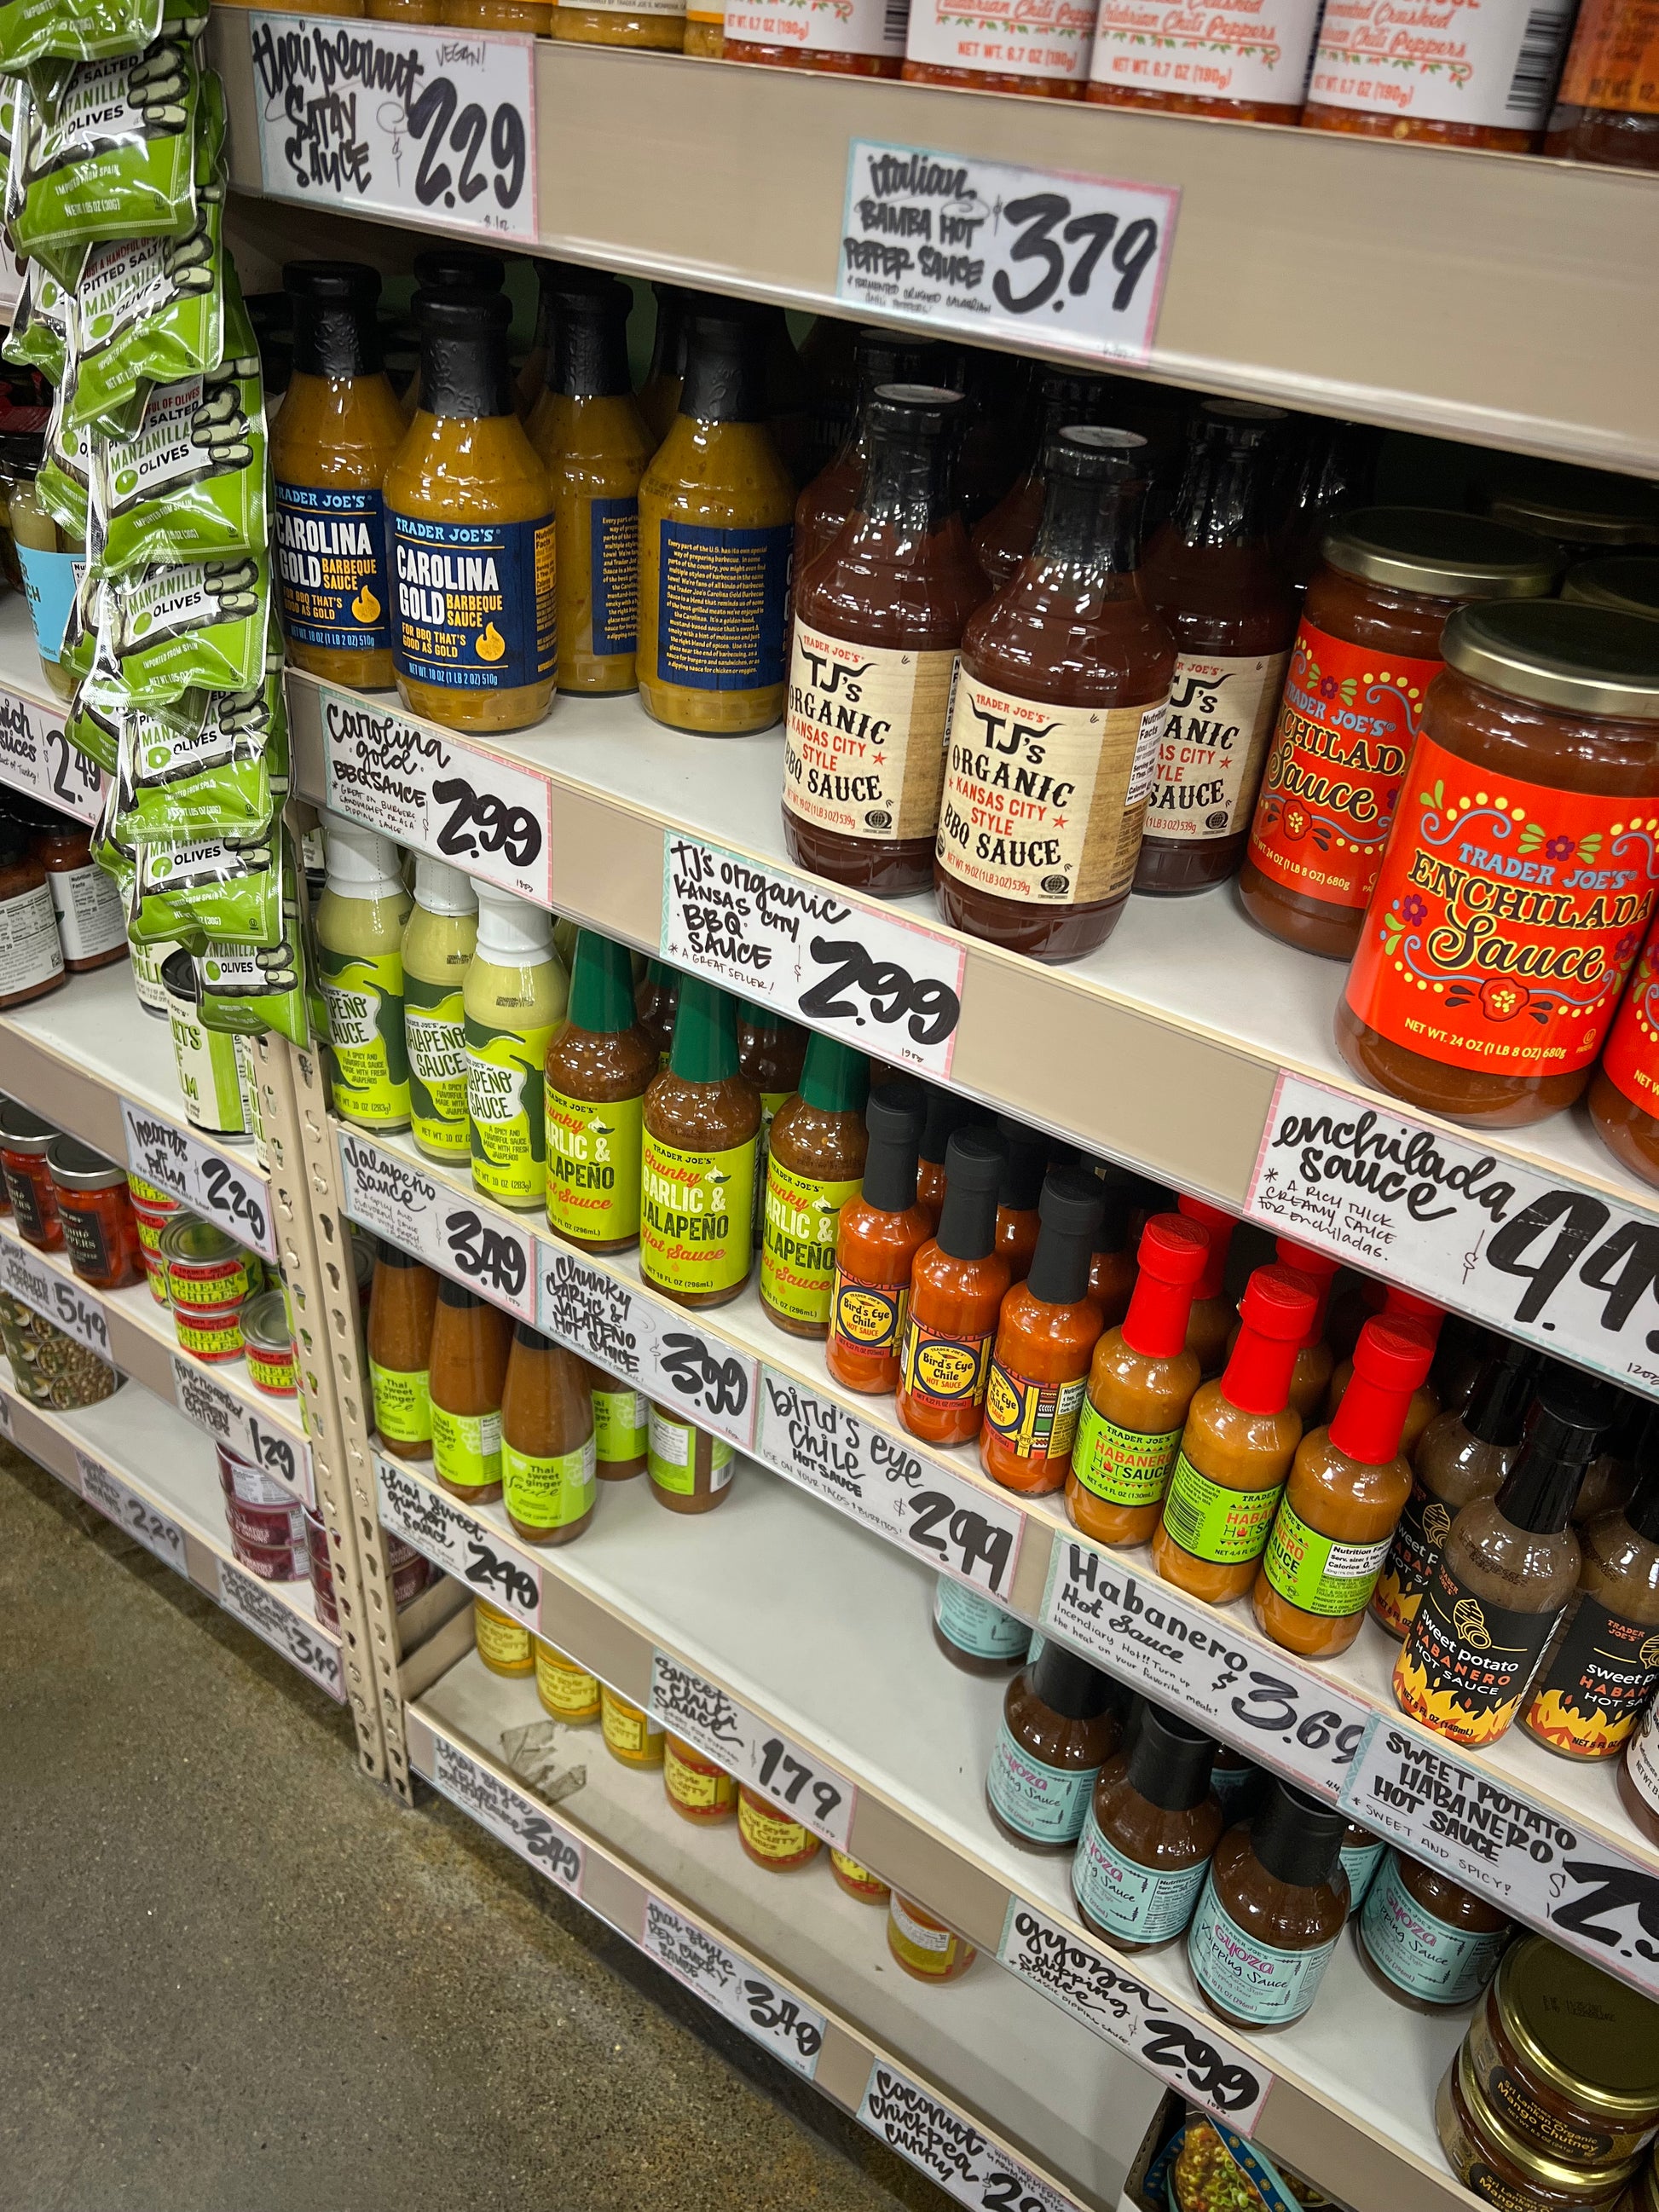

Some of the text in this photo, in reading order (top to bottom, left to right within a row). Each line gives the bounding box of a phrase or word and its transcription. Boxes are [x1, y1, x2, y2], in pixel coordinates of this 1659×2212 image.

[958, 41, 980, 58] NET
[83, 55, 139, 84] SALTED
[67, 105, 124, 135] OLIVES
[939, 214, 985, 251] HOT
[917, 245, 985, 290] SAUCE
[149, 401, 199, 428] SALTED
[109, 424, 191, 471] MANZANILLA
[138, 444, 190, 476] OLIVES
[396, 545, 500, 592] CAROLINA
[129, 567, 204, 616] MANZANILLA
[153, 592, 203, 619] OLIVES
[398, 582, 503, 626] GOLD BARBEQUE
[402, 621, 467, 647] FOR BBQ THAT'S
[402, 635, 459, 659] GOOD AS GOLD
[788, 684, 892, 746] ORGANIC
[1330, 707, 1388, 738] JOE'S
[173, 731, 218, 756] OLIVES
[791, 715, 867, 759] KANSAS CITY
[1179, 744, 1217, 765] CITY
[356, 739, 418, 777] gold
[802, 744, 838, 772] STYLE
[951, 743, 1076, 809] ORGANIC
[332, 759, 427, 808] BBQ SAUCE
[956, 777, 1049, 823] KANSAS CITY
[1148, 777, 1226, 811] SAUCE
[1269, 742, 1378, 823] Sauce
[943, 800, 1062, 869] BBQ SAUCE
[970, 807, 1014, 837] STYLE
[174, 845, 222, 867] OLIVES
[1457, 842, 1627, 891] TRADER JOE'S
[720, 862, 852, 925] organic
[1408, 847, 1655, 931] ENCHILADA
[673, 874, 801, 943] KANSAS CITY
[681, 904, 744, 939] BBQ
[687, 932, 773, 970] SAUCE
[1425, 900, 1607, 985] Sauce
[220, 961, 254, 973] OLIVES
[692, 954, 726, 974] GREAT
[1404, 1016, 1425, 1036] NET
[1426, 1024, 1448, 1044] WT.
[1448, 1032, 1464, 1048] 24
[1465, 1037, 1484, 1052] OZ
[1494, 1042, 1510, 1057] LB
[1511, 1045, 1519, 1057] 8
[1520, 1045, 1542, 1061] OZ)
[1541, 1045, 1567, 1060] 680g
[416, 1053, 467, 1078] SAUCE
[1271, 1109, 1517, 1223] enchilada
[1299, 1146, 1458, 1222] sauce
[557, 1187, 614, 1211] Sauce
[643, 1164, 727, 1214] GARLIC &
[1305, 1185, 1343, 1210] RICH
[642, 1194, 730, 1242] JALAPEÑO
[1344, 1216, 1398, 1245] SAUCE
[775, 1267, 833, 1292] Sauce
[852, 1314, 876, 1330] Chile
[922, 1353, 974, 1372] Bird's Eye
[933, 1368, 960, 1381] Chile
[925, 1376, 962, 1390] HOT SAUCE
[1095, 1438, 1174, 1469] HABANERO
[1106, 1424, 1172, 1447] TRADER JOE'S
[529, 1465, 555, 1475] Thai
[792, 1448, 863, 1499] HOT SAUCE
[870, 1434, 925, 1489] eye
[1121, 1464, 1171, 1481] SAUCE
[525, 1478, 563, 1490] ginger
[1061, 1583, 1102, 1620] Hot
[1068, 1543, 1249, 1672] Habanero
[1420, 1608, 1520, 1674] sweet potato
[1607, 1619, 1647, 1638] TRADER
[1097, 1644, 1112, 1656] on
[1115, 1652, 1138, 1672] your
[1414, 1639, 1500, 1696] HOT SAUCE
[1415, 1620, 1512, 1687] HABANERO
[1586, 1663, 1637, 1686] sweet
[1583, 1691, 1625, 1708] HOT
[1385, 1730, 1578, 1851] SWEET POTATO
[1365, 1803, 1413, 1838] SWEET
[1419, 1836, 1451, 1860] AND
[1373, 1774, 1505, 1863] HOT SAUCE
[1399, 1762, 1555, 1865] HABANERO
